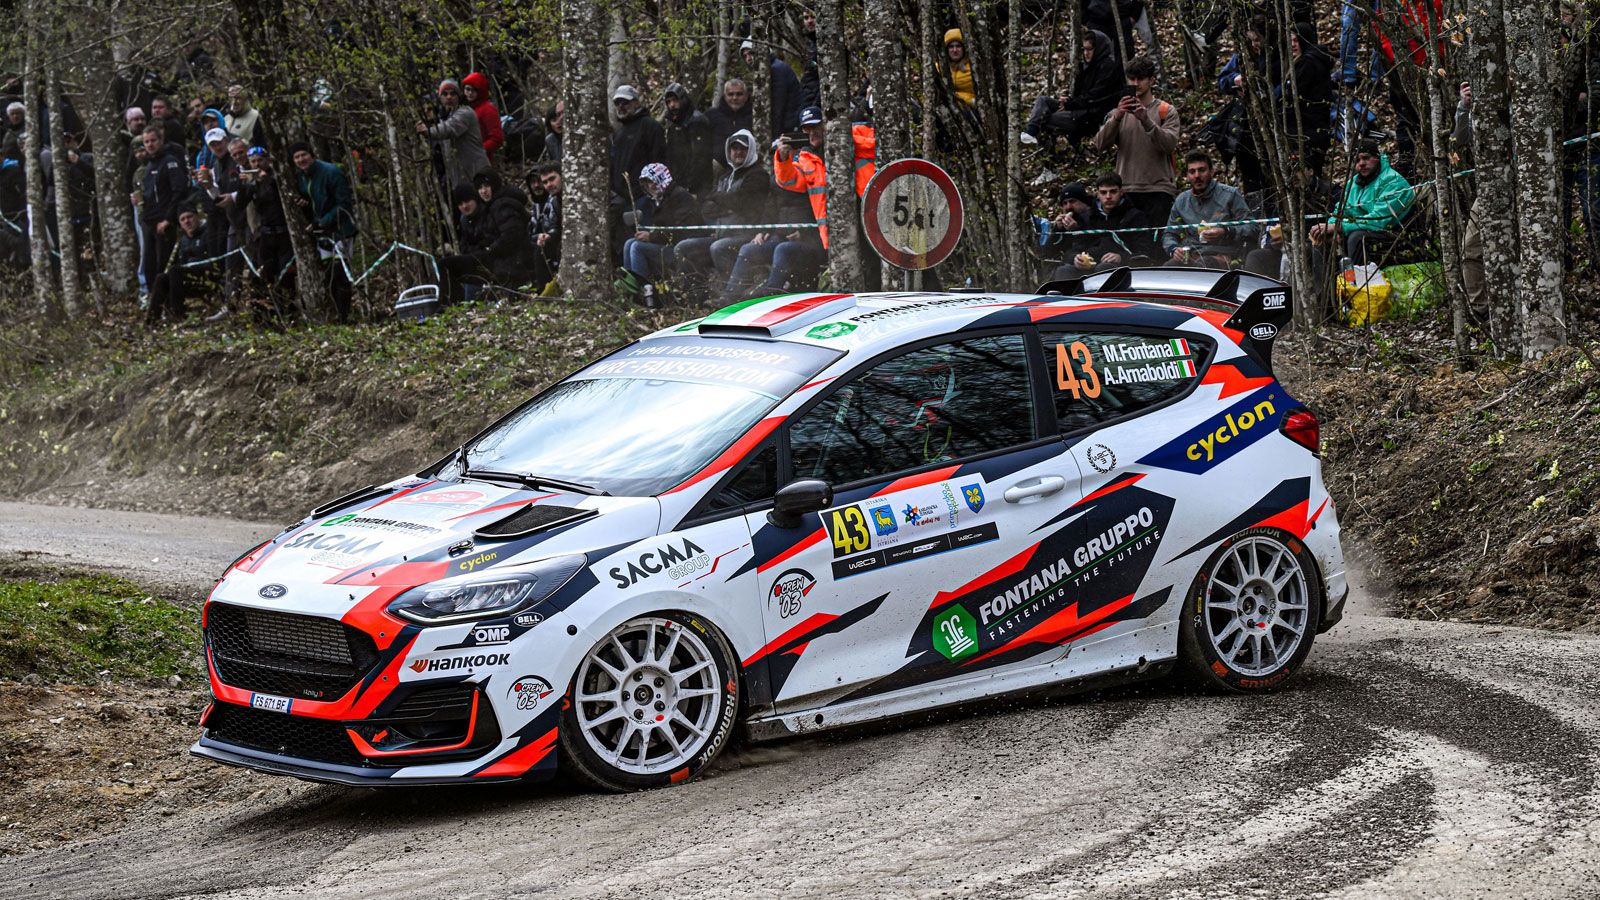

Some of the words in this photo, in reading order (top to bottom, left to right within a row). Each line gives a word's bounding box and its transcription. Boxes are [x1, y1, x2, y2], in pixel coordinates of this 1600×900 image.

[1263, 294, 1285, 307] OMP
[849, 303, 925, 322] FONTANA
[1253, 326, 1274, 336] BELL
[666, 345, 790, 365] MOTORSPORT
[1102, 343, 1173, 363] M.Fontana
[588, 361, 782, 387] WRC-FANSHOP.COM
[1056, 340, 1102, 400] 43
[1103, 363, 1180, 386] A.Arnaboldi
[1186, 399, 1275, 462] cyclon
[832, 507, 869, 554] 43
[283, 533, 384, 555] SACMA
[459, 552, 497, 571] cyclon
[609, 537, 705, 590] SACMA
[668, 553, 710, 580] GROUP
[848, 557, 877, 569] WRC3
[979, 558, 1072, 625] FONTANA
[1073, 507, 1153, 568] GRUPPO
[261, 585, 285, 598] Ford
[990, 588, 1065, 640] FASTENING
[1075, 567, 1100, 587] THE
[1109, 531, 1161, 567] FUTURE
[518, 615, 539, 624] BELL
[475, 628, 509, 642] OMP
[255, 696, 263, 705] FS
[264, 697, 275, 707] 671
[276, 699, 286, 708] BF
